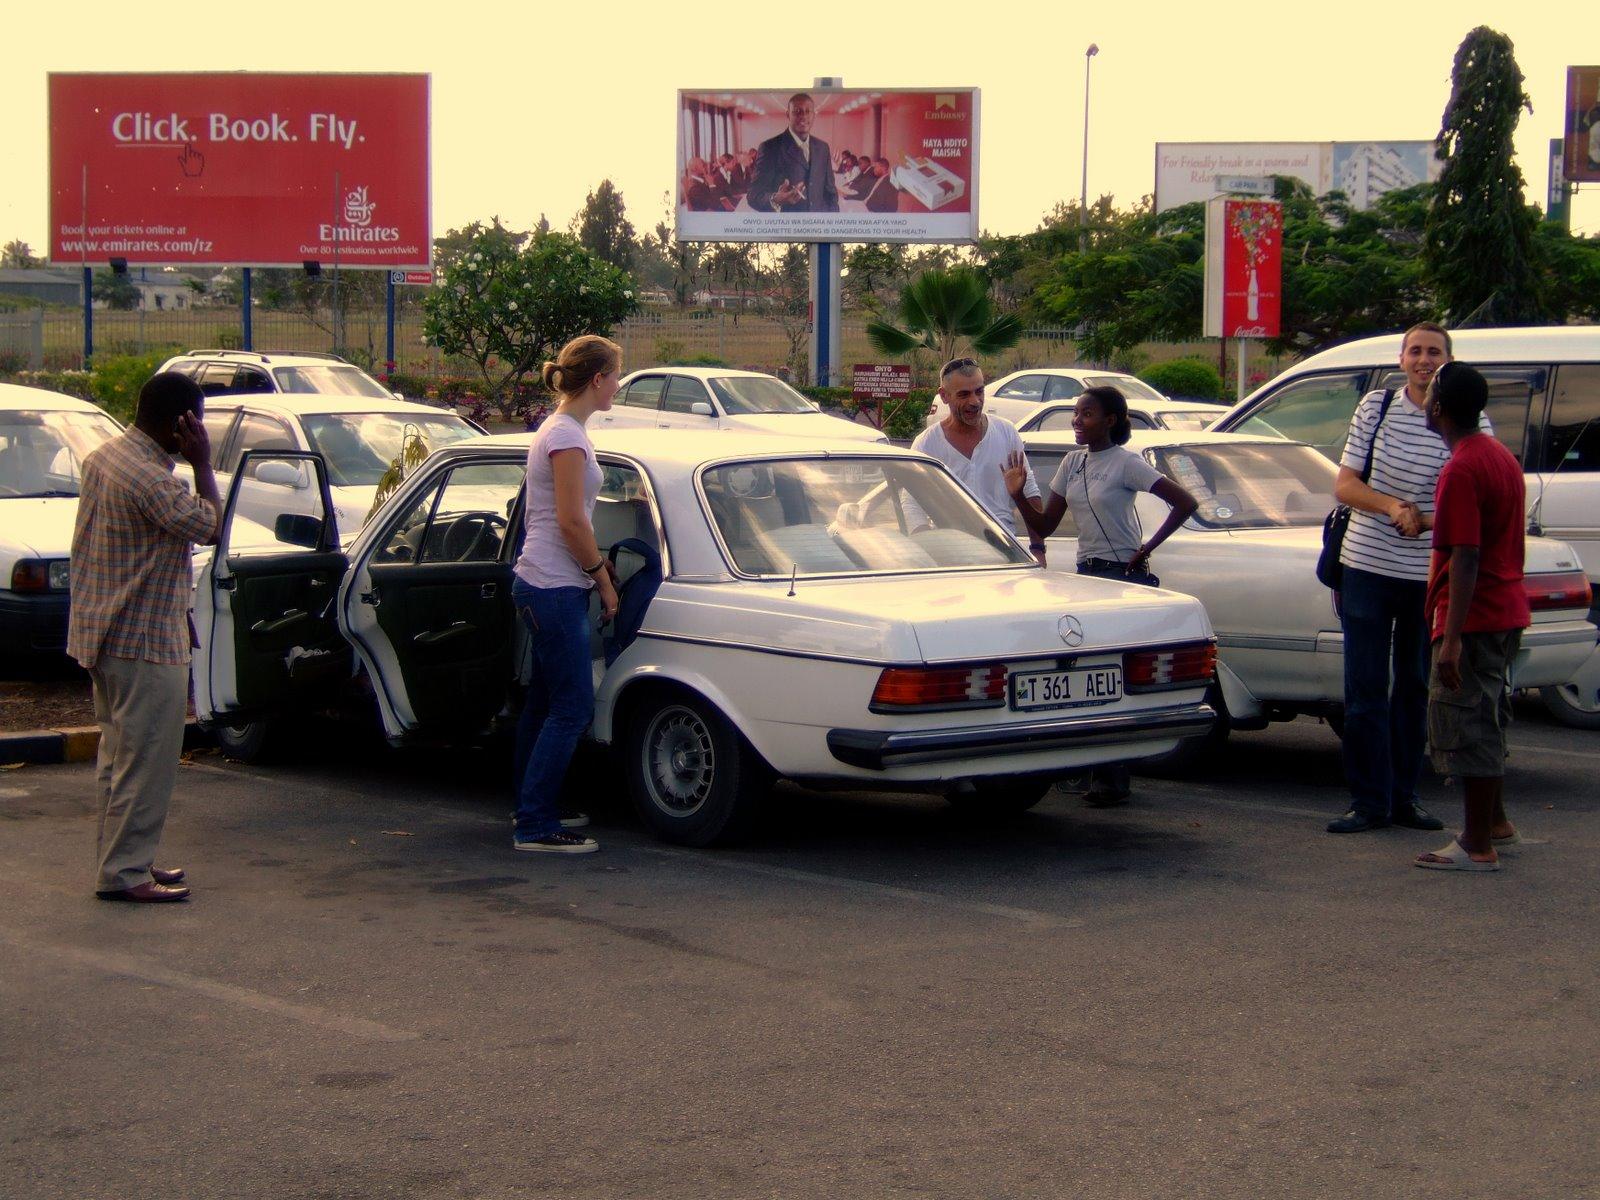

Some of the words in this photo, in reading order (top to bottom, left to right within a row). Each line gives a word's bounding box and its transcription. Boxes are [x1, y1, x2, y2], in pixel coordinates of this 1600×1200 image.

[924, 110, 967, 121] Embassy
[112, 112, 197, 142] Click.
[209, 112, 298, 142] Book.
[310, 113, 365, 150] Fly.
[923, 138, 942, 148] HAYA
[944, 138, 968, 148] NDIYO
[932, 148, 961, 158] MAISHA
[1163, 155, 1178, 168] For
[61, 225, 85, 235] Book
[88, 226, 110, 237] your
[113, 224, 144, 235] tickets
[145, 224, 174, 235] online
[177, 226, 186, 235] at
[319, 223, 400, 242] Emirates
[61, 238, 213, 255] www.emirates.com/tz
[300, 245, 318, 254] Over
[320, 246, 331, 254] 80
[378, 246, 419, 255] worldwide
[1028, 677, 1037, 701] T
[1042, 675, 1071, 700] 361
[1086, 672, 1116, 697] AEU
